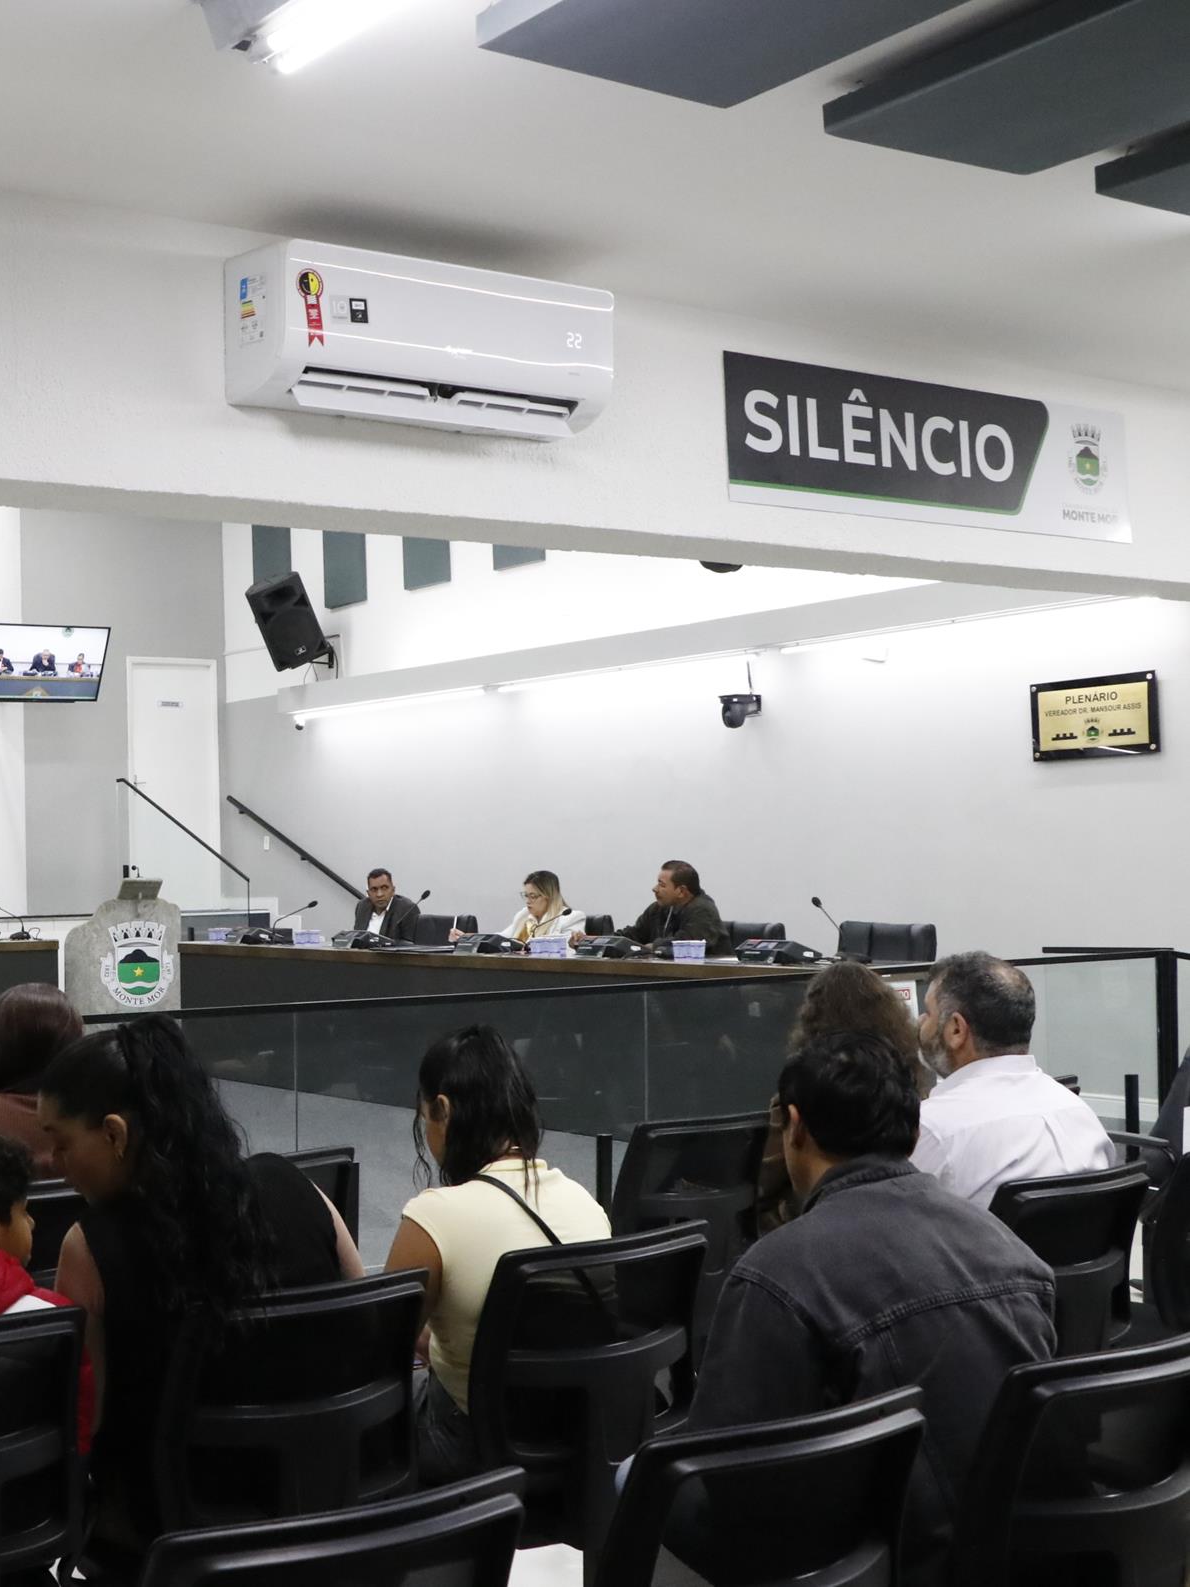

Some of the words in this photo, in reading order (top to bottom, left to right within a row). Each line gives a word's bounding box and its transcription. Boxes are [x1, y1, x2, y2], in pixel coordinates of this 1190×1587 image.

[566, 332, 582, 349] 22
[743, 389, 1015, 483] SILÊNCIO
[1062, 509, 1097, 523] MONTE
[1065, 691, 1118, 705] PLENÁRIO
[1044, 707, 1078, 717] VEREADOR
[1090, 704, 1122, 713] MANSOUR
[1123, 702, 1142, 710] ASSIS
[113, 987, 145, 1005] MONTE
[147, 986, 165, 1003] MOR
